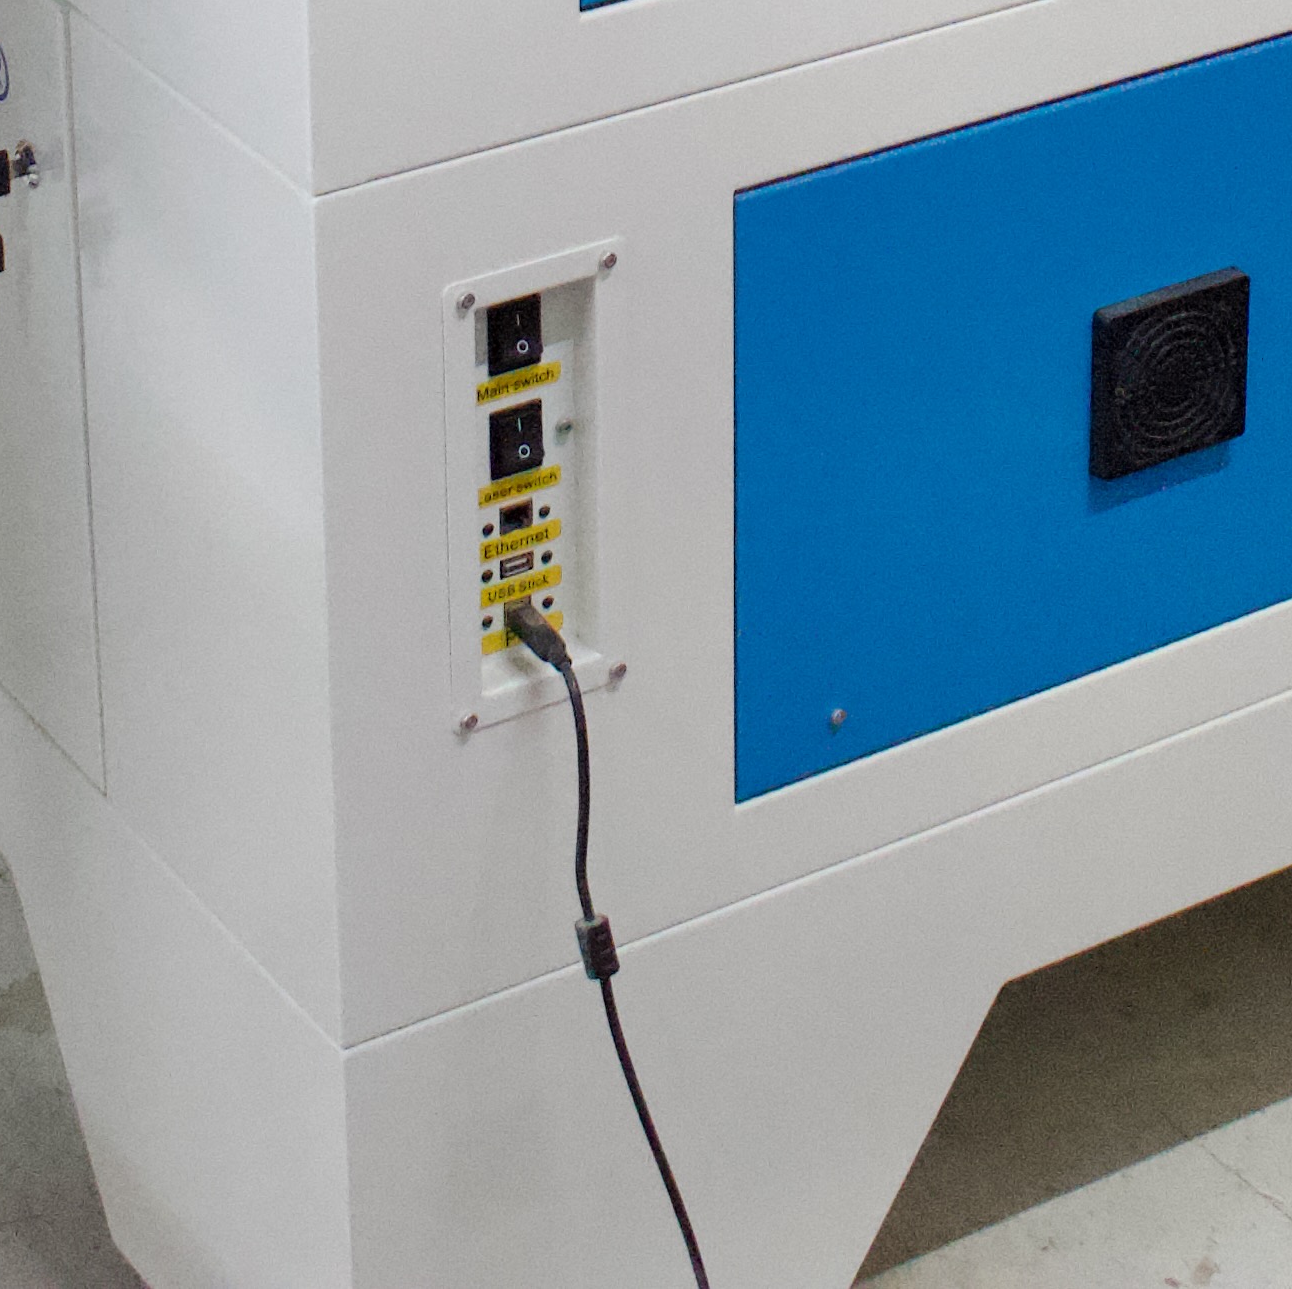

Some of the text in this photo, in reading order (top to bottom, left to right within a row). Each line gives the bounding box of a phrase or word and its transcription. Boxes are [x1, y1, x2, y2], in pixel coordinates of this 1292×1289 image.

[484, 528, 549, 559] Ethernet
[488, 574, 550, 603] USB Stick
